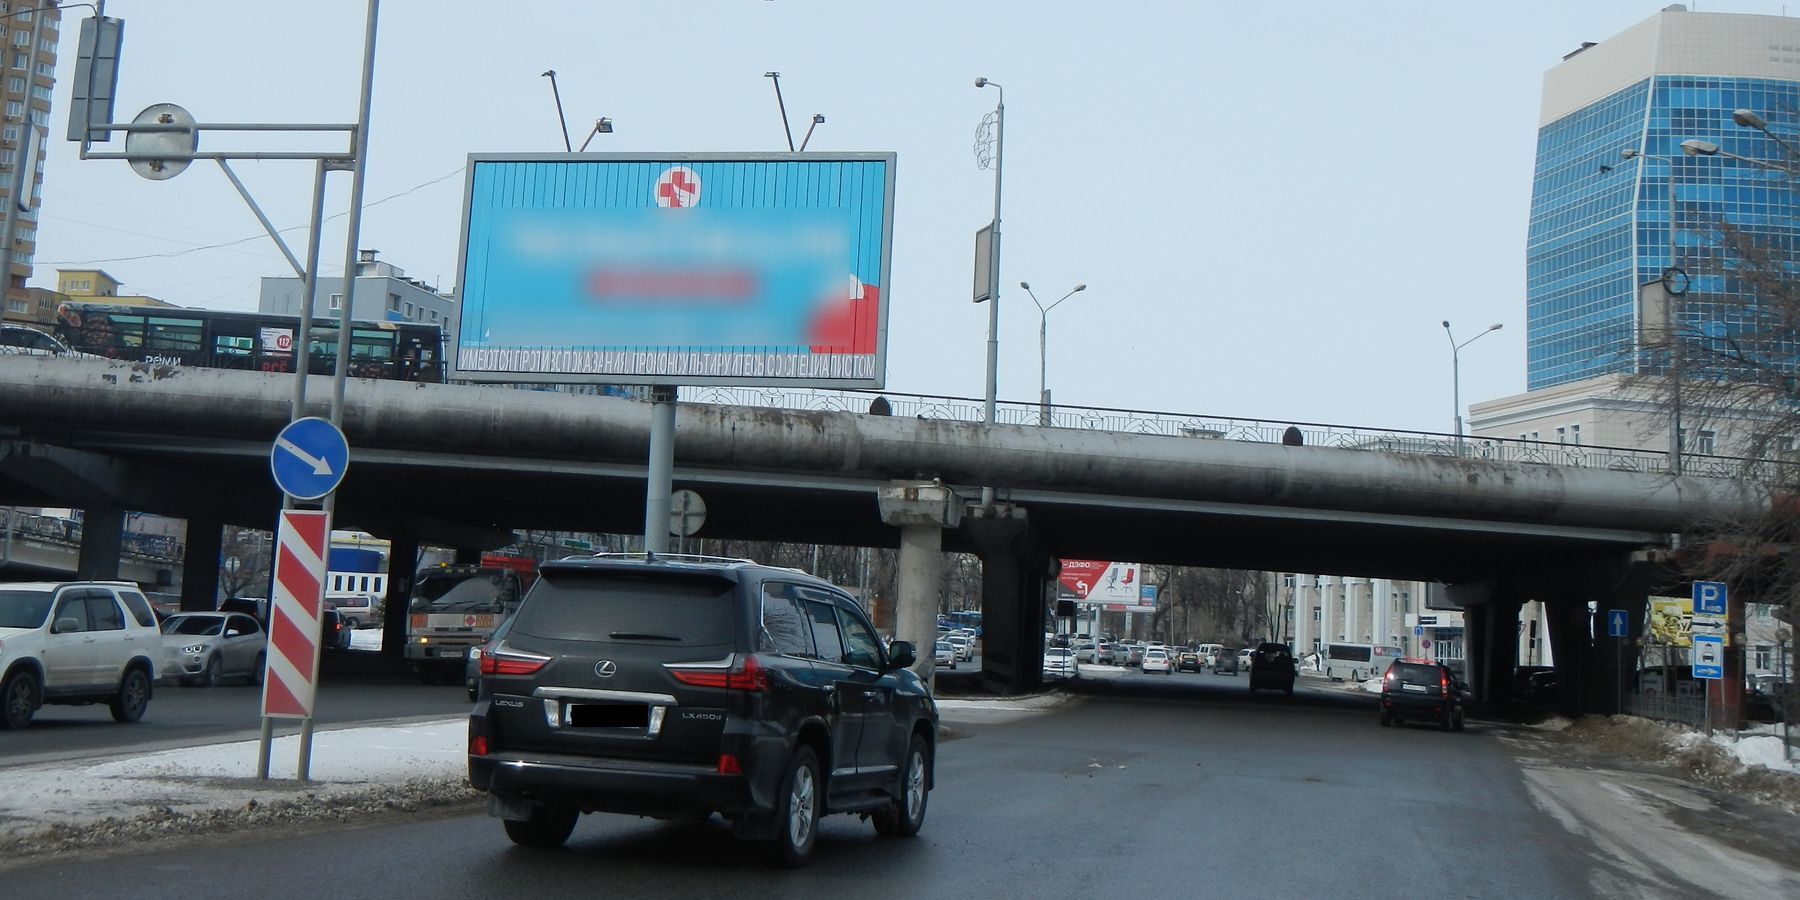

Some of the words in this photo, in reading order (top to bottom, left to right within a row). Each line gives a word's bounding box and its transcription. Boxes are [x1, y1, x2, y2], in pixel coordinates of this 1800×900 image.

[278, 337, 290, 347] 112
[461, 349, 512, 371] ИМЕЮТСЯ
[631, 352, 764, 376] ПРОКОНСУЛЬТИРУЙТЕСЬ
[765, 354, 781, 375] СО
[784, 354, 876, 379] СПЕЦИАЛИСТОМ
[1700, 585, 1719, 610] P
[495, 699, 524, 708] LEXUS
